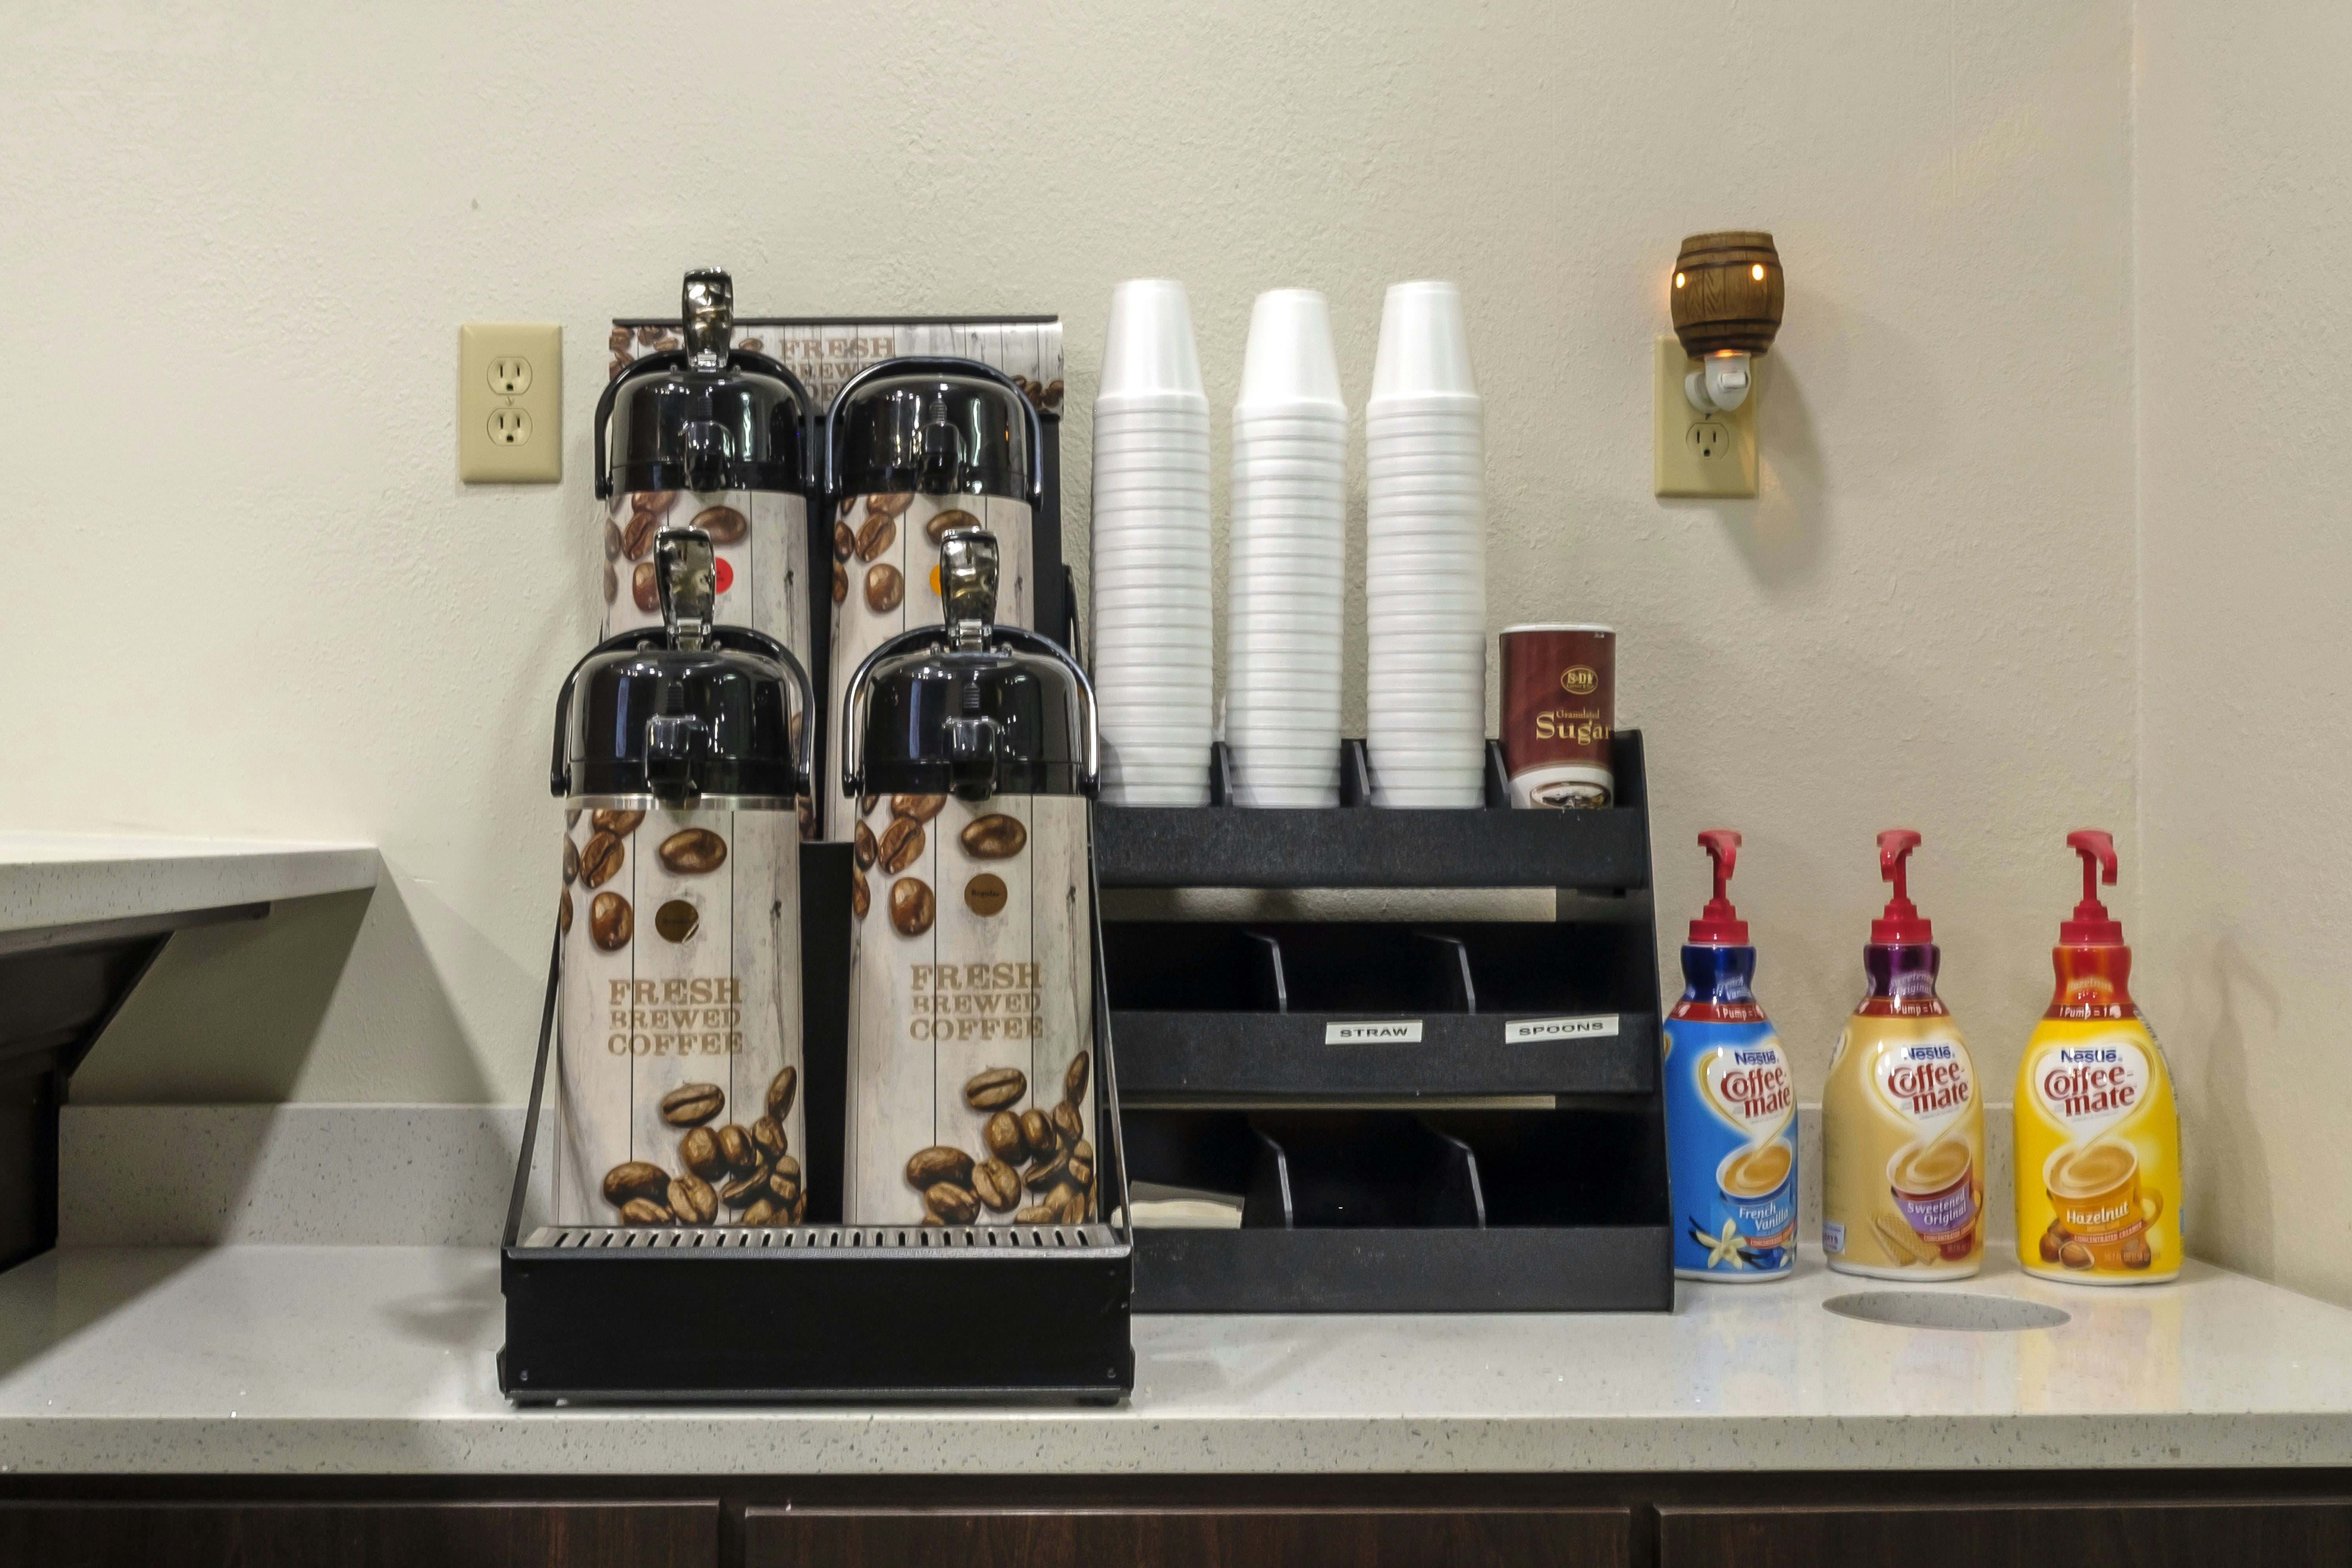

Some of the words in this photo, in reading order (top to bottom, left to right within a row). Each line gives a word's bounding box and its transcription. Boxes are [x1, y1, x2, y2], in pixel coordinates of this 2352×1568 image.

[780, 337, 893, 359] FRESH
[909, 962, 1042, 990] FRESH
[608, 978, 742, 1006] FRESH
[911, 992, 1041, 1015] BREWED
[609, 1008, 741, 1030] BREWED
[1723, 1005, 1747, 1021] Pump
[2065, 1005, 2091, 1020] Pump
[909, 1016, 1043, 1041] COFFEE
[1340, 1025, 1408, 1038] STRAW
[1519, 1020, 1604, 1036] SPOONS
[608, 1031, 743, 1056] COFFEE
[1744, 1087, 1791, 1119] mate
[1913, 1082, 1969, 1114] mate
[2065, 1086, 2135, 1117] mate
[1739, 1201, 1776, 1219] French
[1907, 1187, 1965, 1214] Sweetened
[1924, 1199, 1967, 1226] Original
[1755, 1207, 1788, 1230] Vanilla
[2066, 1201, 2129, 1225] Hazelnut
